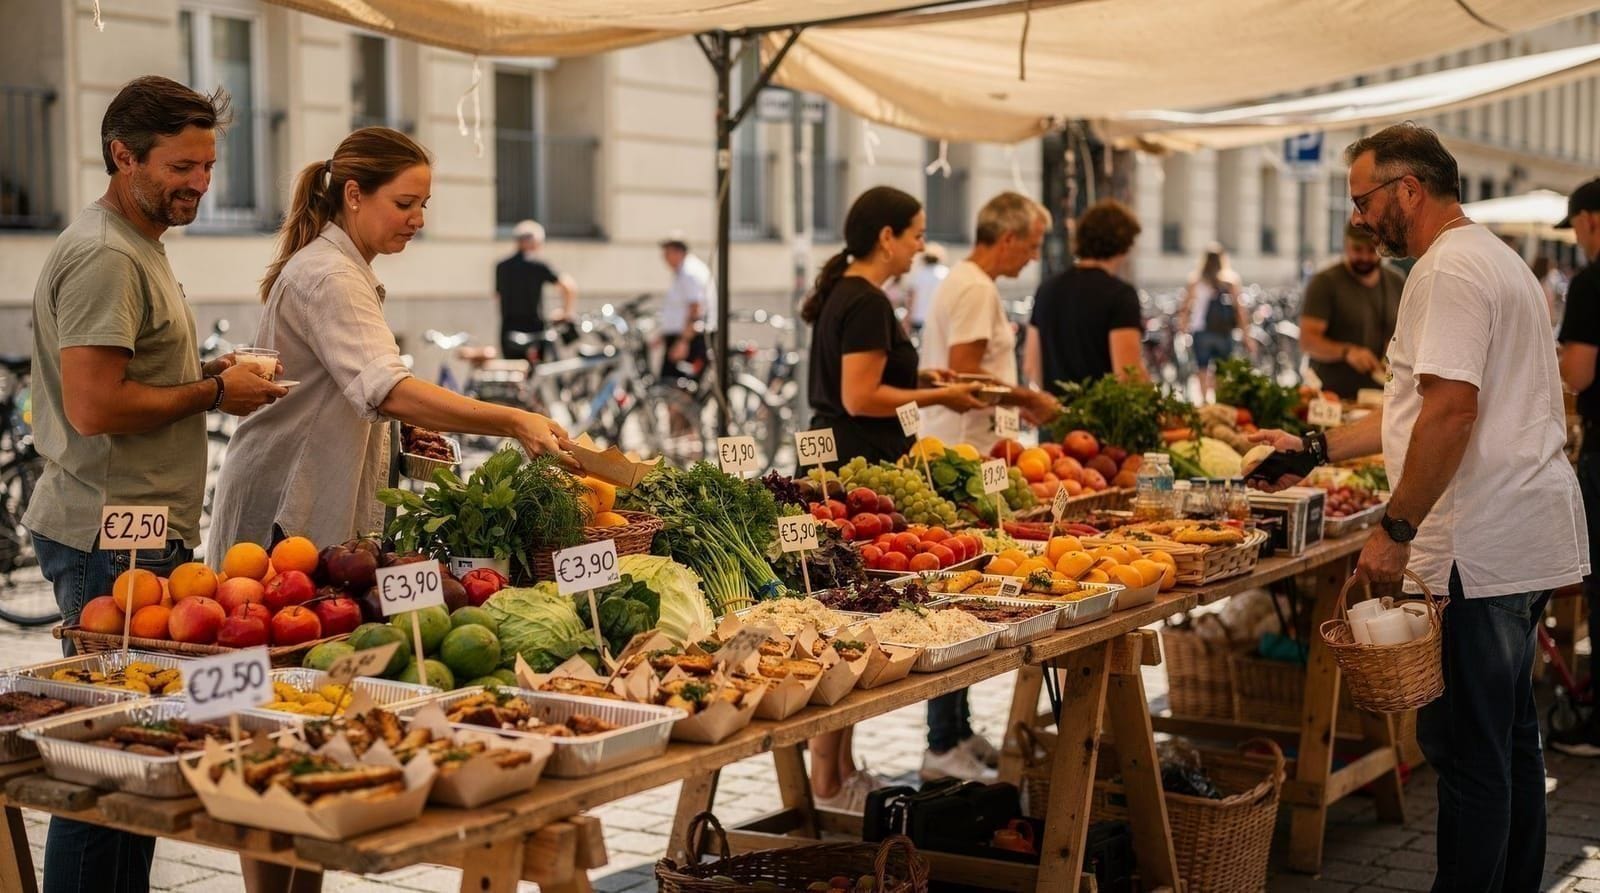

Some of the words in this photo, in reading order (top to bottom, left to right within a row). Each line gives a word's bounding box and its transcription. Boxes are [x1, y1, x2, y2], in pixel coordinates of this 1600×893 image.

[721, 443, 754, 466] €1,90
[800, 436, 833, 457] €5,90
[104, 512, 165, 542] €2,50
[781, 522, 815, 544] €5,90
[557, 550, 614, 583] €3,90
[383, 571, 438, 602] €3,90
[189, 660, 265, 705] €2,50
